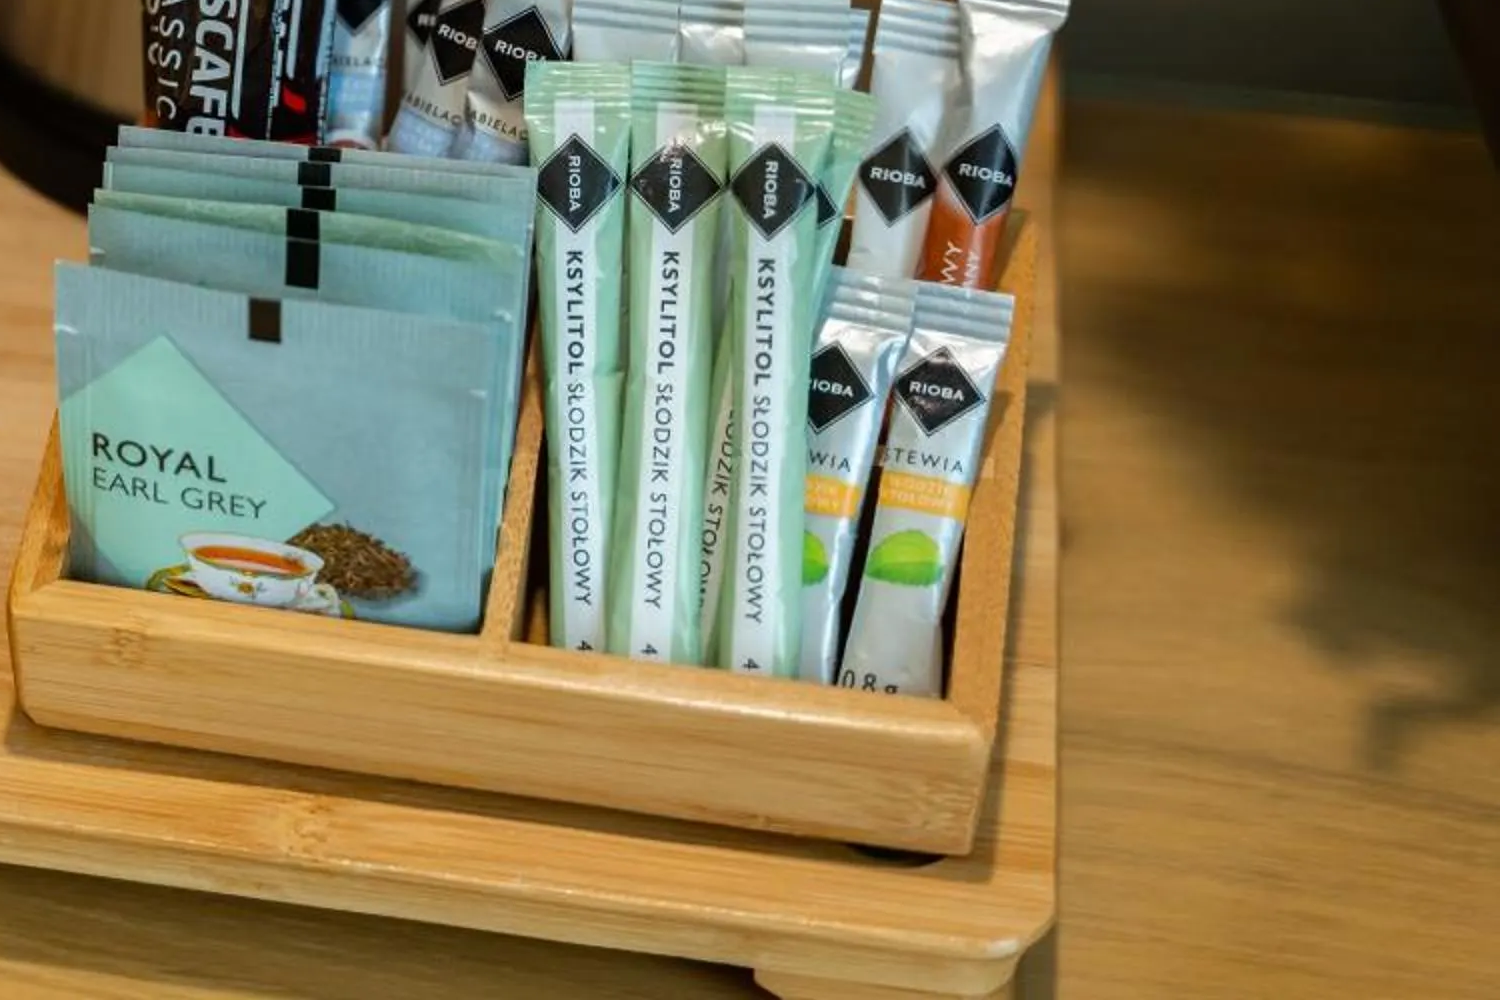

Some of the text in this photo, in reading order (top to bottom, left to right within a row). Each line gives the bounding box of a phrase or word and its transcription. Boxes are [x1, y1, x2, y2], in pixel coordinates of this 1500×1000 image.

[438, 23, 477, 50] RIOB
[568, 154, 584, 212] RIOBA
[667, 158, 684, 213] RIOBA
[762, 160, 780, 219] RIOBA
[869, 166, 926, 189] RIOBA
[958, 162, 1013, 187] RIOBA
[809, 379, 854, 398] IOBA
[908, 380, 965, 402] RIOBA
[565, 250, 591, 606] KSYLITOL SŁODZIK STOŁOWY
[643, 250, 680, 609] KSYLITOL SŁODZIK STOŁOWY
[743, 258, 777, 624] KSYLITOL SŁODZIK STOŁOWY
[91, 431, 228, 484] ROYAL
[92, 467, 267, 519] EARL GREY
